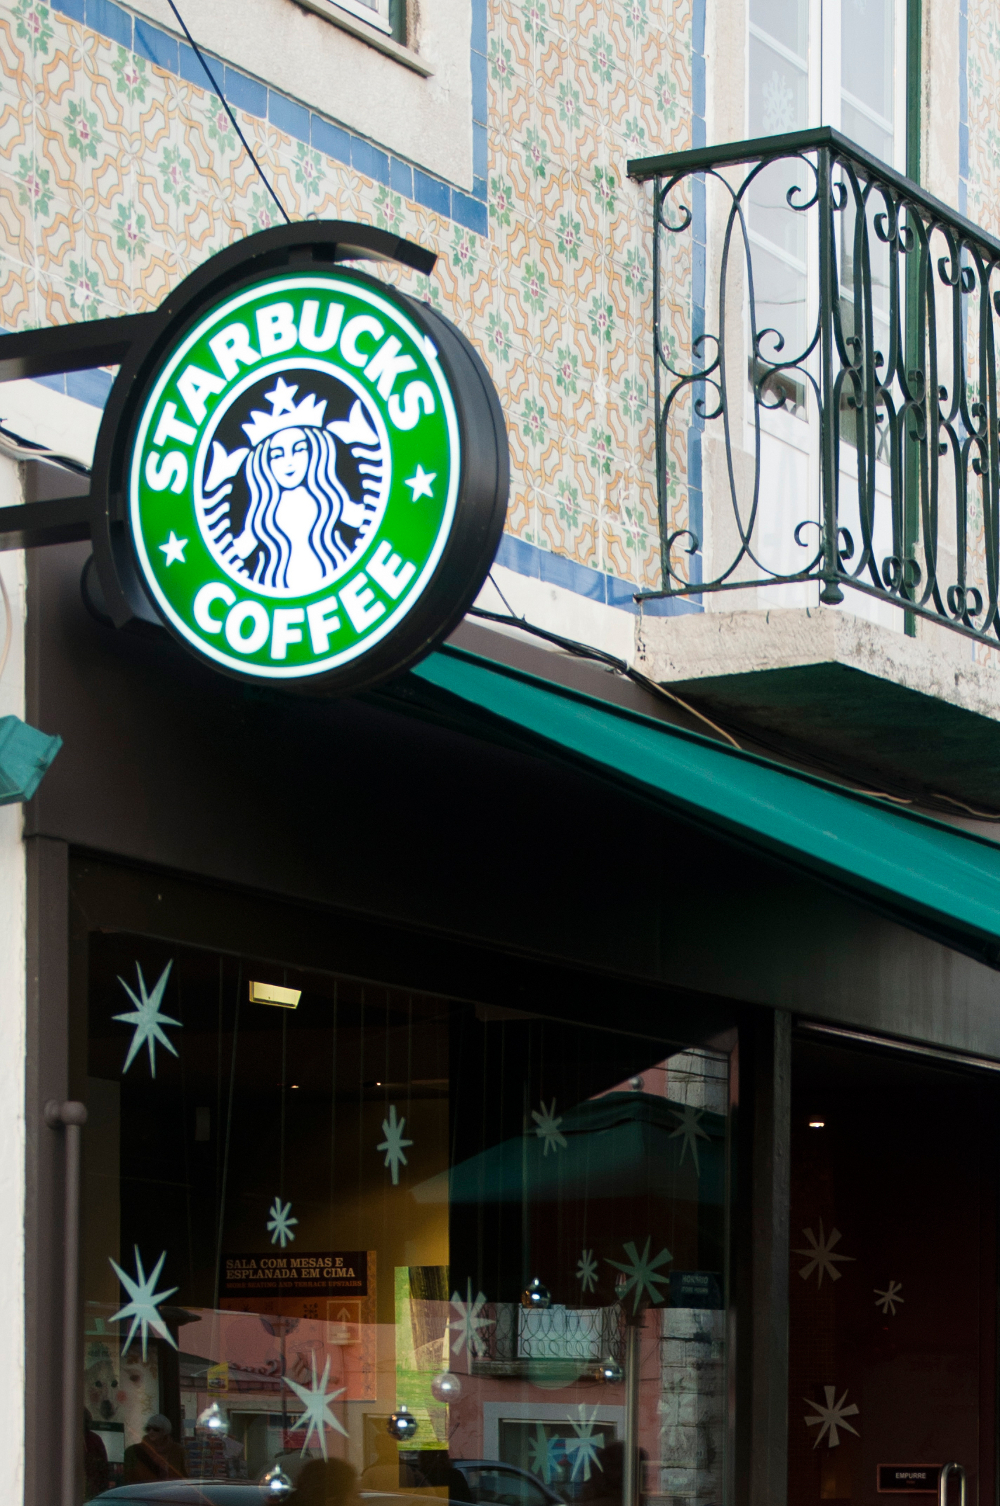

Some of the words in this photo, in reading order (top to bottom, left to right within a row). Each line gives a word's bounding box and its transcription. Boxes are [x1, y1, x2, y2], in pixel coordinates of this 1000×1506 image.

[145, 299, 436, 495] STARBUCKS
[193, 540, 417, 660] COFFEE
[226, 1259, 257, 1269] SALA
[260, 1258, 287, 1268] COM
[290, 1257, 332, 1267] MESAS
[335, 1257, 344, 1267] E
[226, 1269, 298, 1279] ESPLANADA
[301, 1268, 320, 1278] EM
[323, 1267, 355, 1278] CIMA
